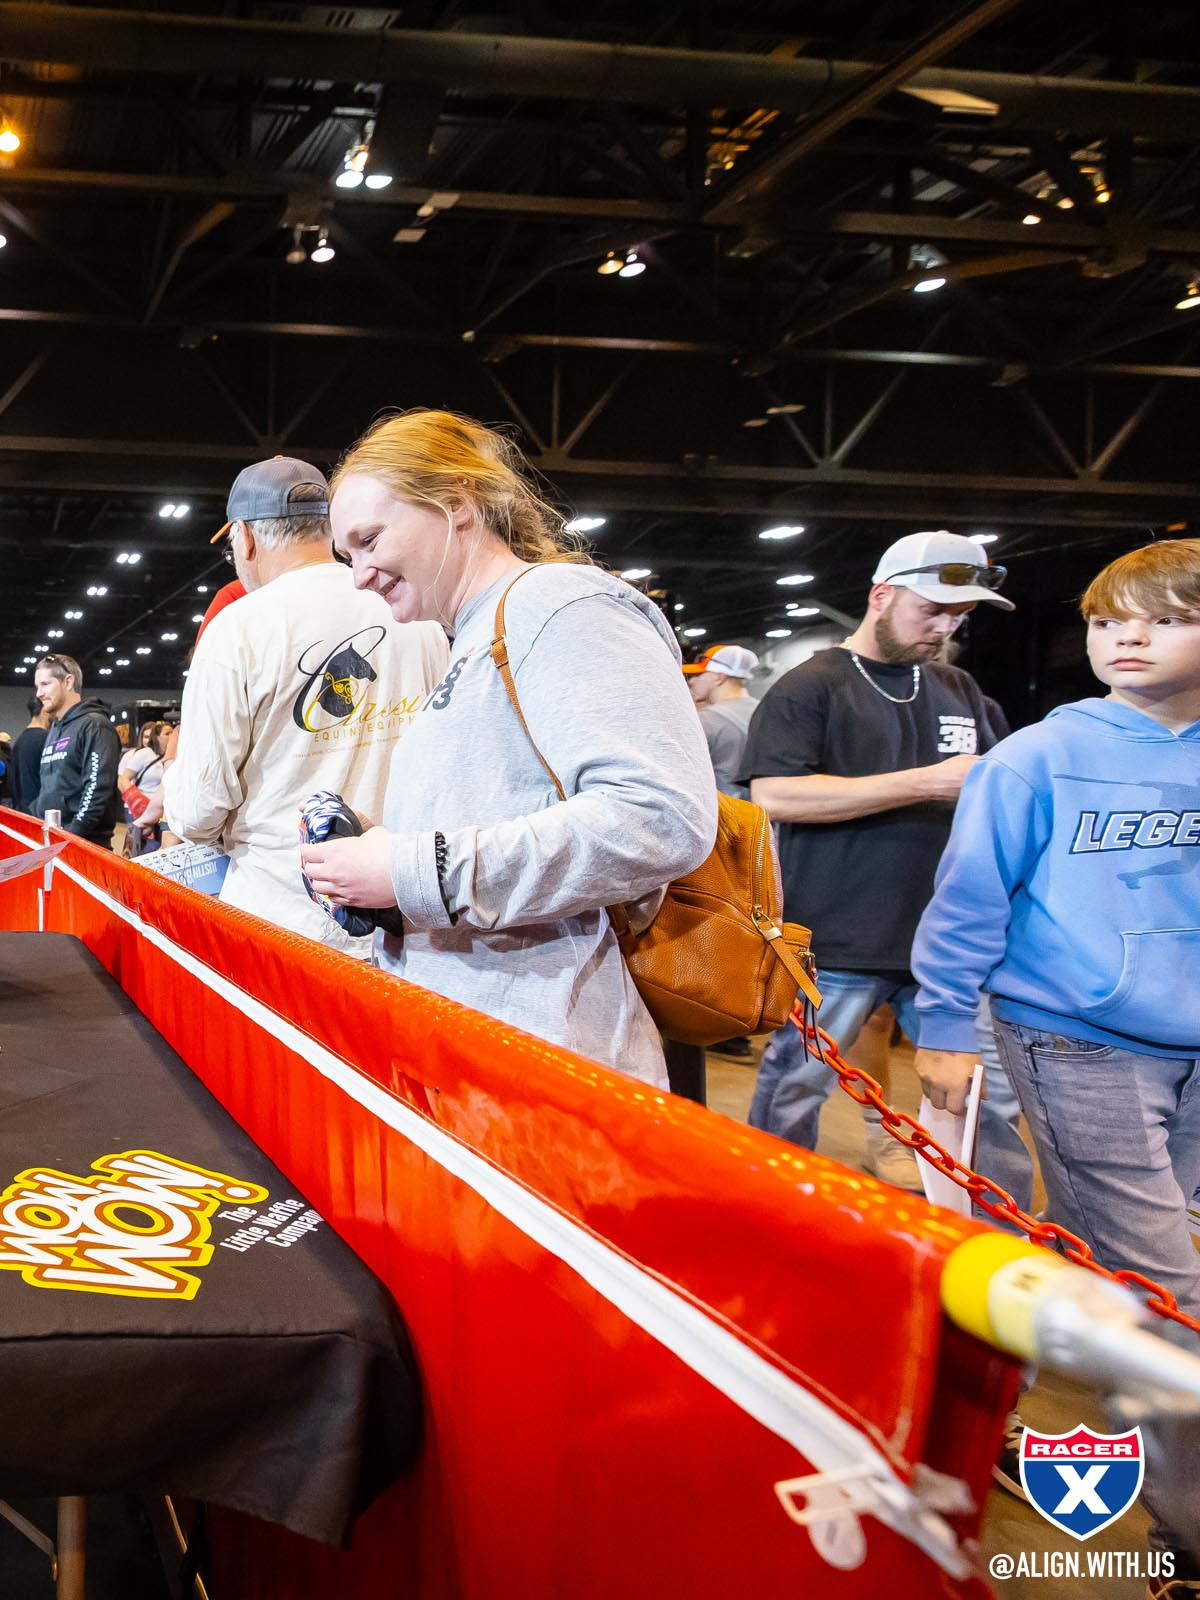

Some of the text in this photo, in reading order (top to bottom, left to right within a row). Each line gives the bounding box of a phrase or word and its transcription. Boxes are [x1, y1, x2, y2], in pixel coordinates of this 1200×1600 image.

[42, 1153, 251, 1291] WOW!
[219, 1204, 258, 1224] The
[220, 1199, 305, 1253] Little Waffle
